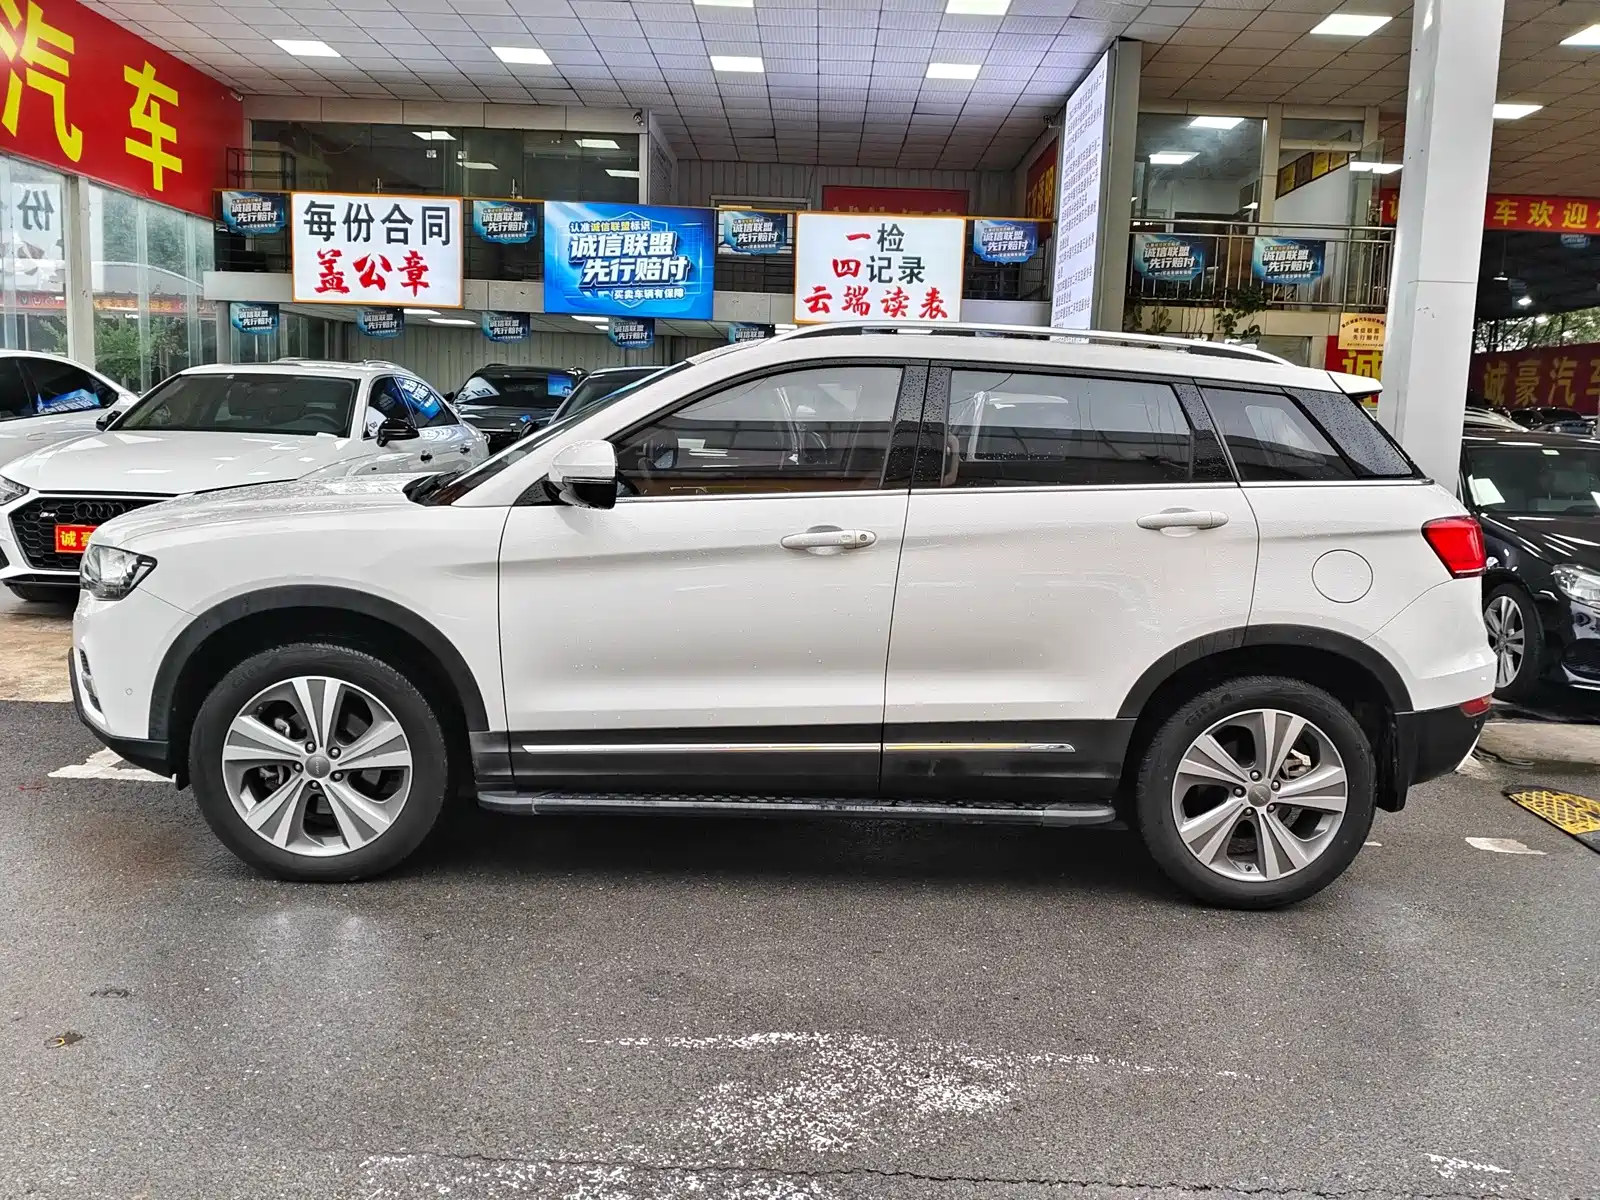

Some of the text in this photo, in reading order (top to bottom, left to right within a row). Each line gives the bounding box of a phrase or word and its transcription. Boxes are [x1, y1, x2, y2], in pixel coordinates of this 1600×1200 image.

[0, 0, 183, 192] 汽车
[231, 201, 272, 213] 诚信联盟
[237, 210, 278, 223] 先行赔付
[482, 211, 523, 223] 诚信联盟
[1493, 199, 1600, 229] 车欢迎
[303, 200, 451, 246] 每份合同
[487, 220, 529, 233] 先行赔付
[569, 220, 651, 233] 认准诚信联盟标识
[732, 221, 773, 233] 诚信联盟
[737, 231, 778, 243] 先行赔付
[846, 223, 905, 253] 一检
[982, 230, 1024, 242] 诚信联盟
[569, 232, 676, 258] 诚信联盟
[987, 239, 1029, 252] 先行赔付
[1144, 245, 1191, 258] 诚信联盟
[1263, 249, 1310, 261] 诚信联盟
[583, 255, 689, 283] 先行赔付
[1148, 256, 1196, 269] 先行赔付
[1267, 259, 1315, 272] 先行赔付
[314, 248, 431, 297] 盖公章
[832, 255, 926, 286] 四记录
[613, 287, 686, 300] 买卖车辆有保障
[803, 285, 949, 319] 云端读表
